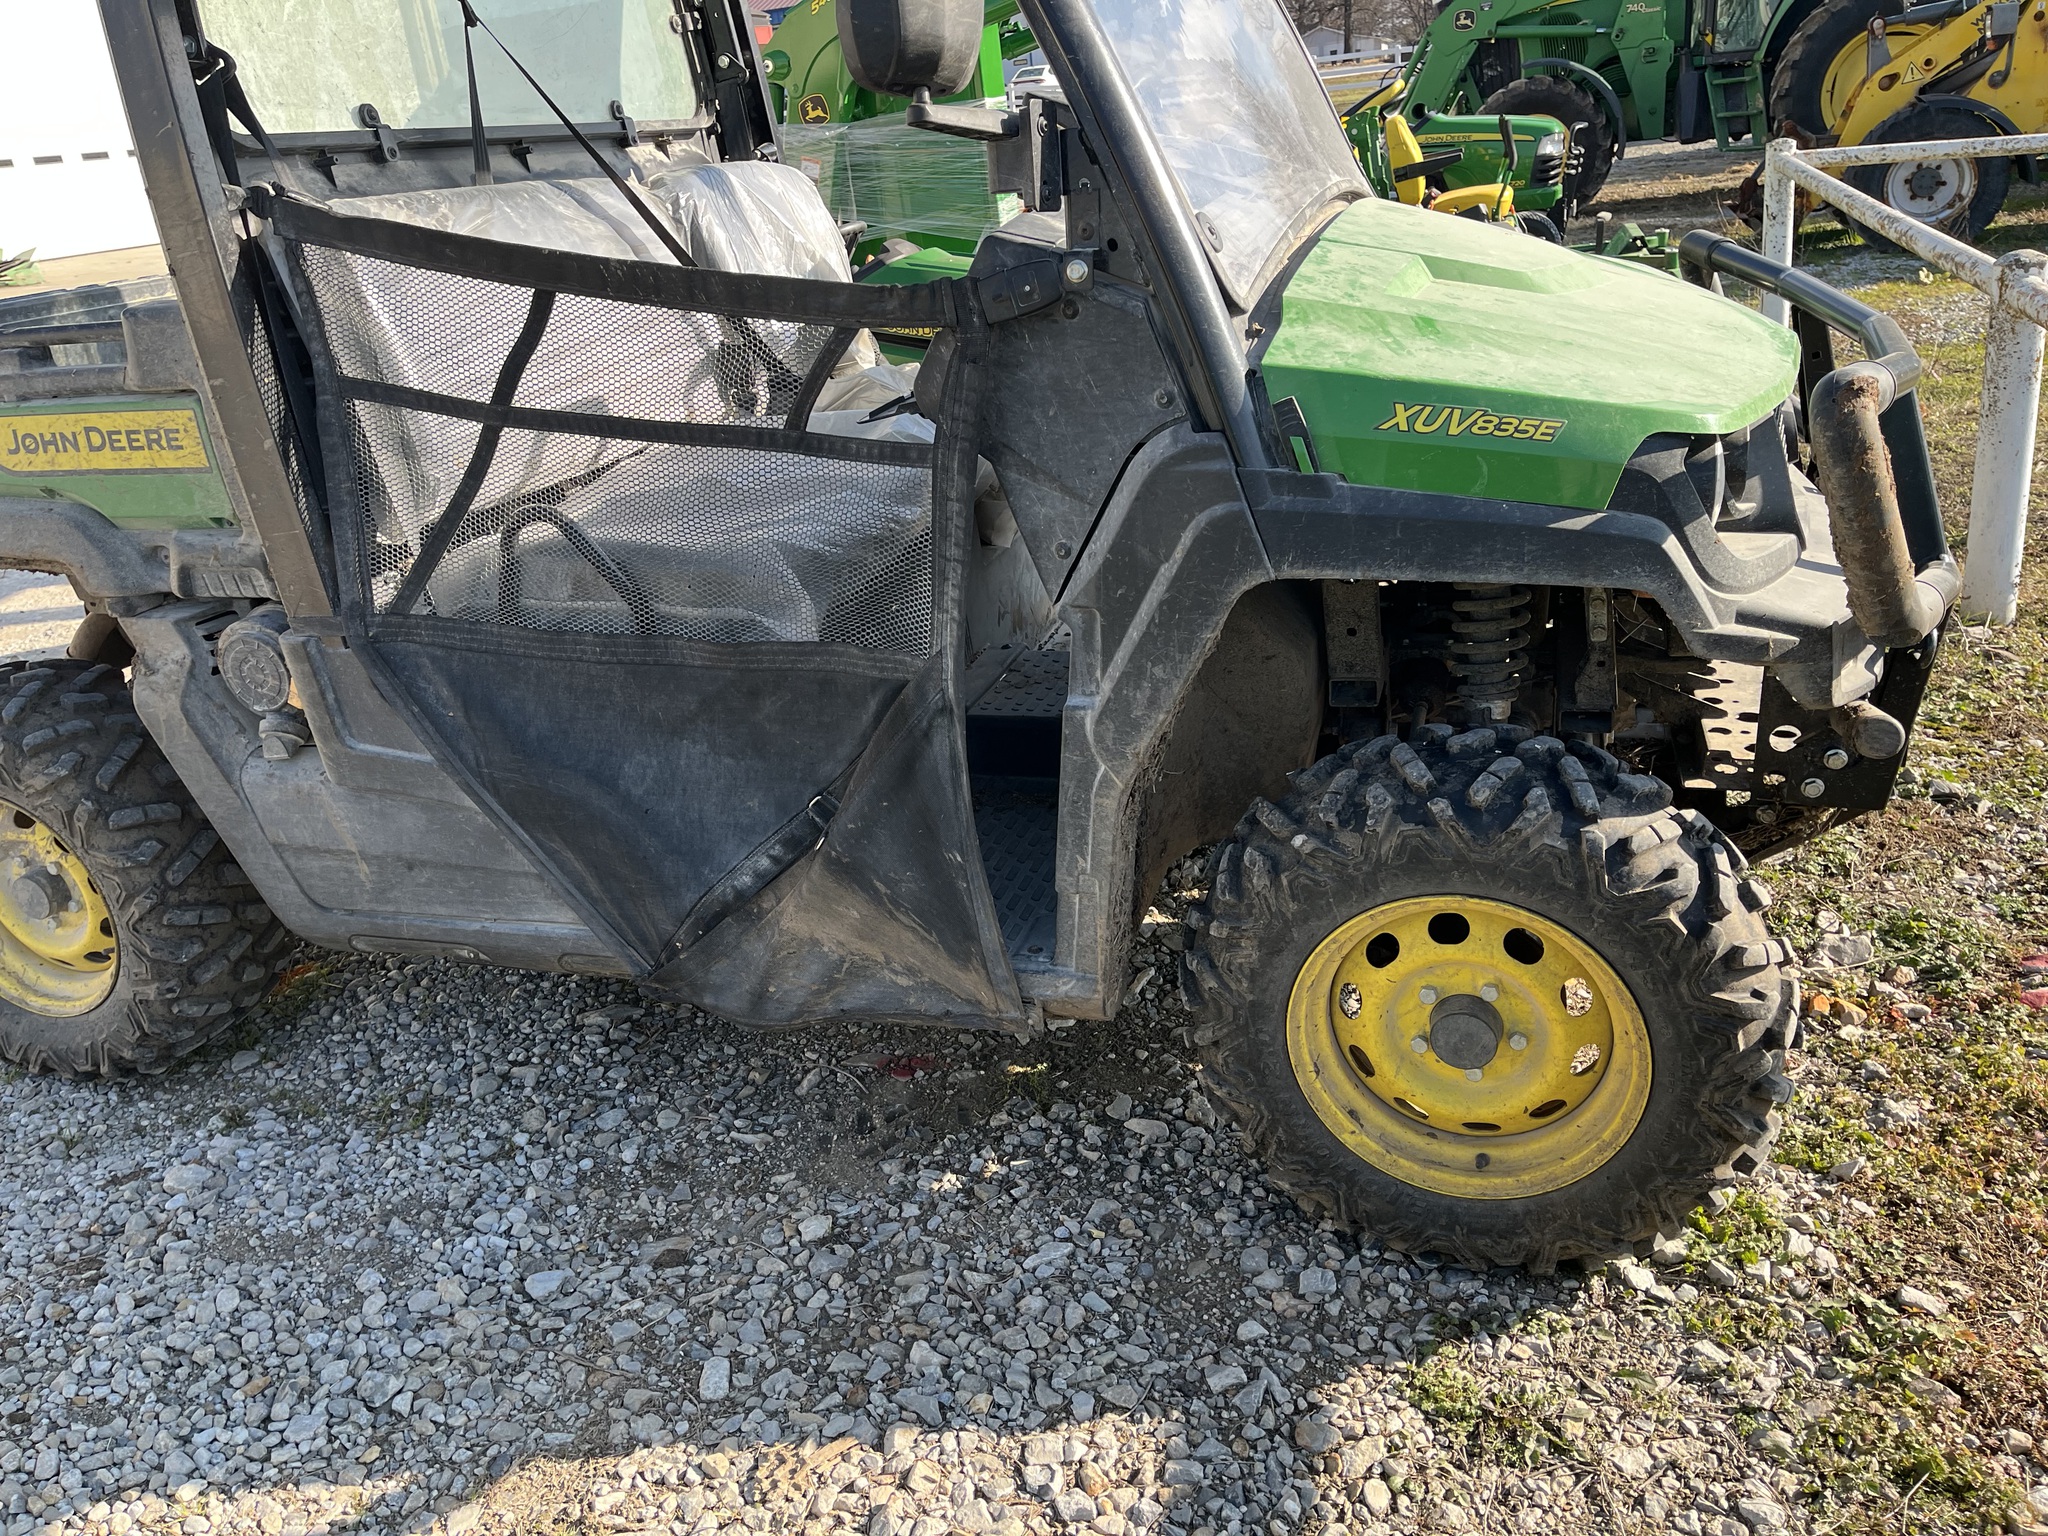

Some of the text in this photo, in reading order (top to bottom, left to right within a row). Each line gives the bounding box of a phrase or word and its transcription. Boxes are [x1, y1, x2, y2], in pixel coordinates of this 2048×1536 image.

[1626, 2, 1646, 12] 740
[1446, 134, 1472, 142] DEERE
[1375, 402, 1567, 442] XUV835E
[8, 426, 184, 455] JOHN DEERE
